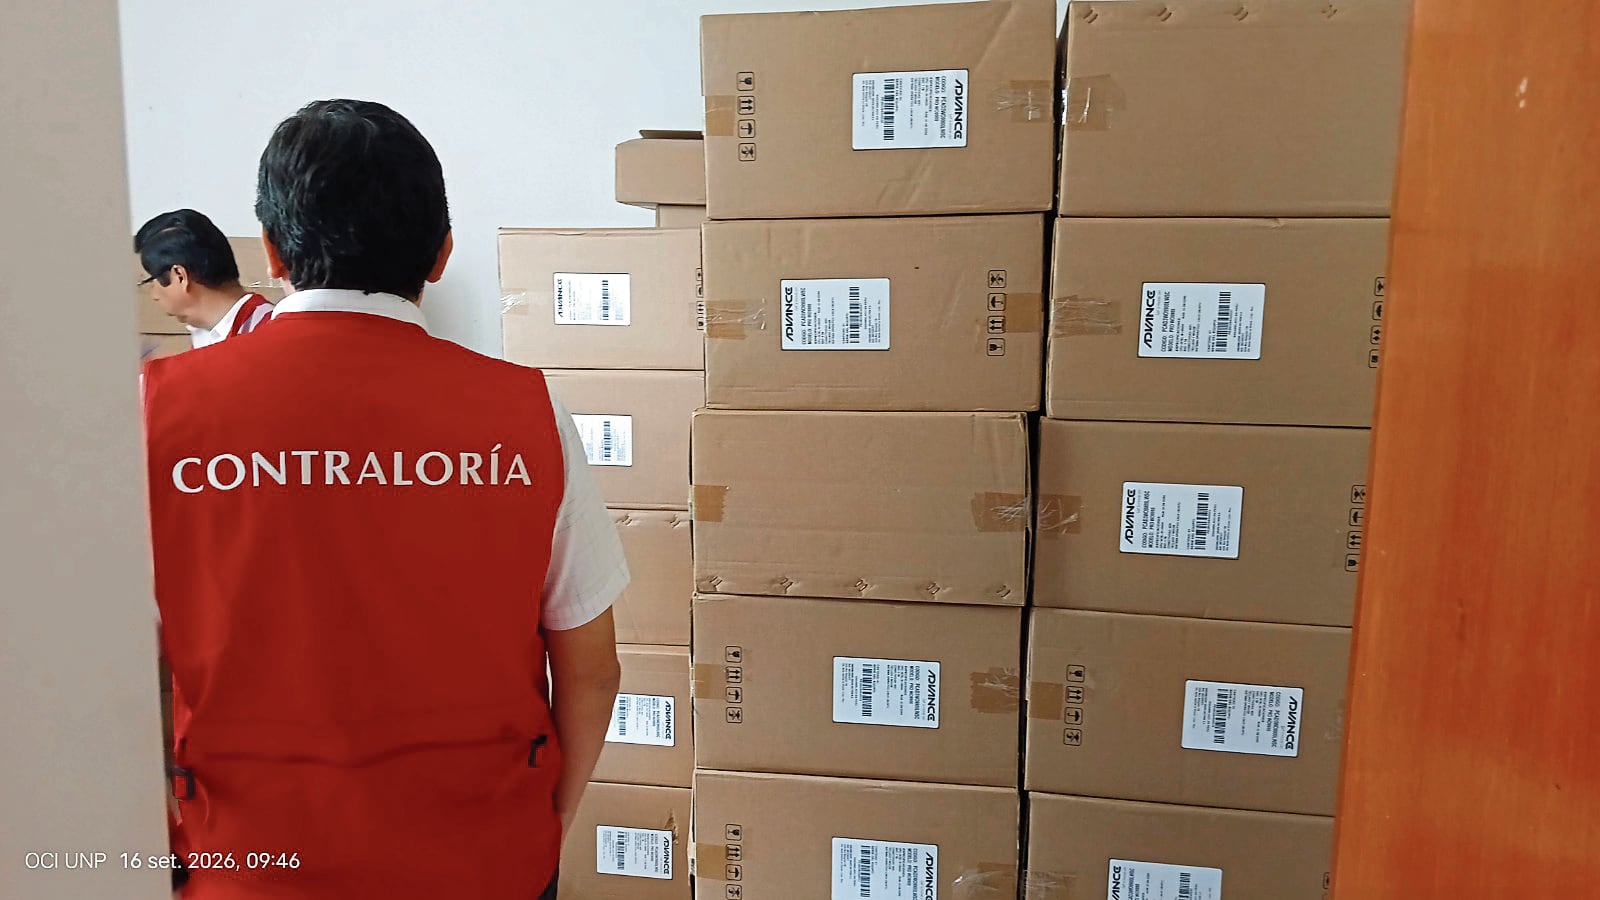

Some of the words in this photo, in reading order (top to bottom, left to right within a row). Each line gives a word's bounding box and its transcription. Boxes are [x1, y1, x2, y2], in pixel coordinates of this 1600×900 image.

[954, 79, 963, 139] ADVANCE
[785, 287, 793, 341] ADVANCE
[1144, 290, 1155, 348] ADVANCE
[172, 443, 532, 494] CONTRALORÍA
[1125, 489, 1135, 544] ADVANCE
[928, 670, 936, 721] ADVANCE
[1286, 696, 1297, 750] ADVANCE
